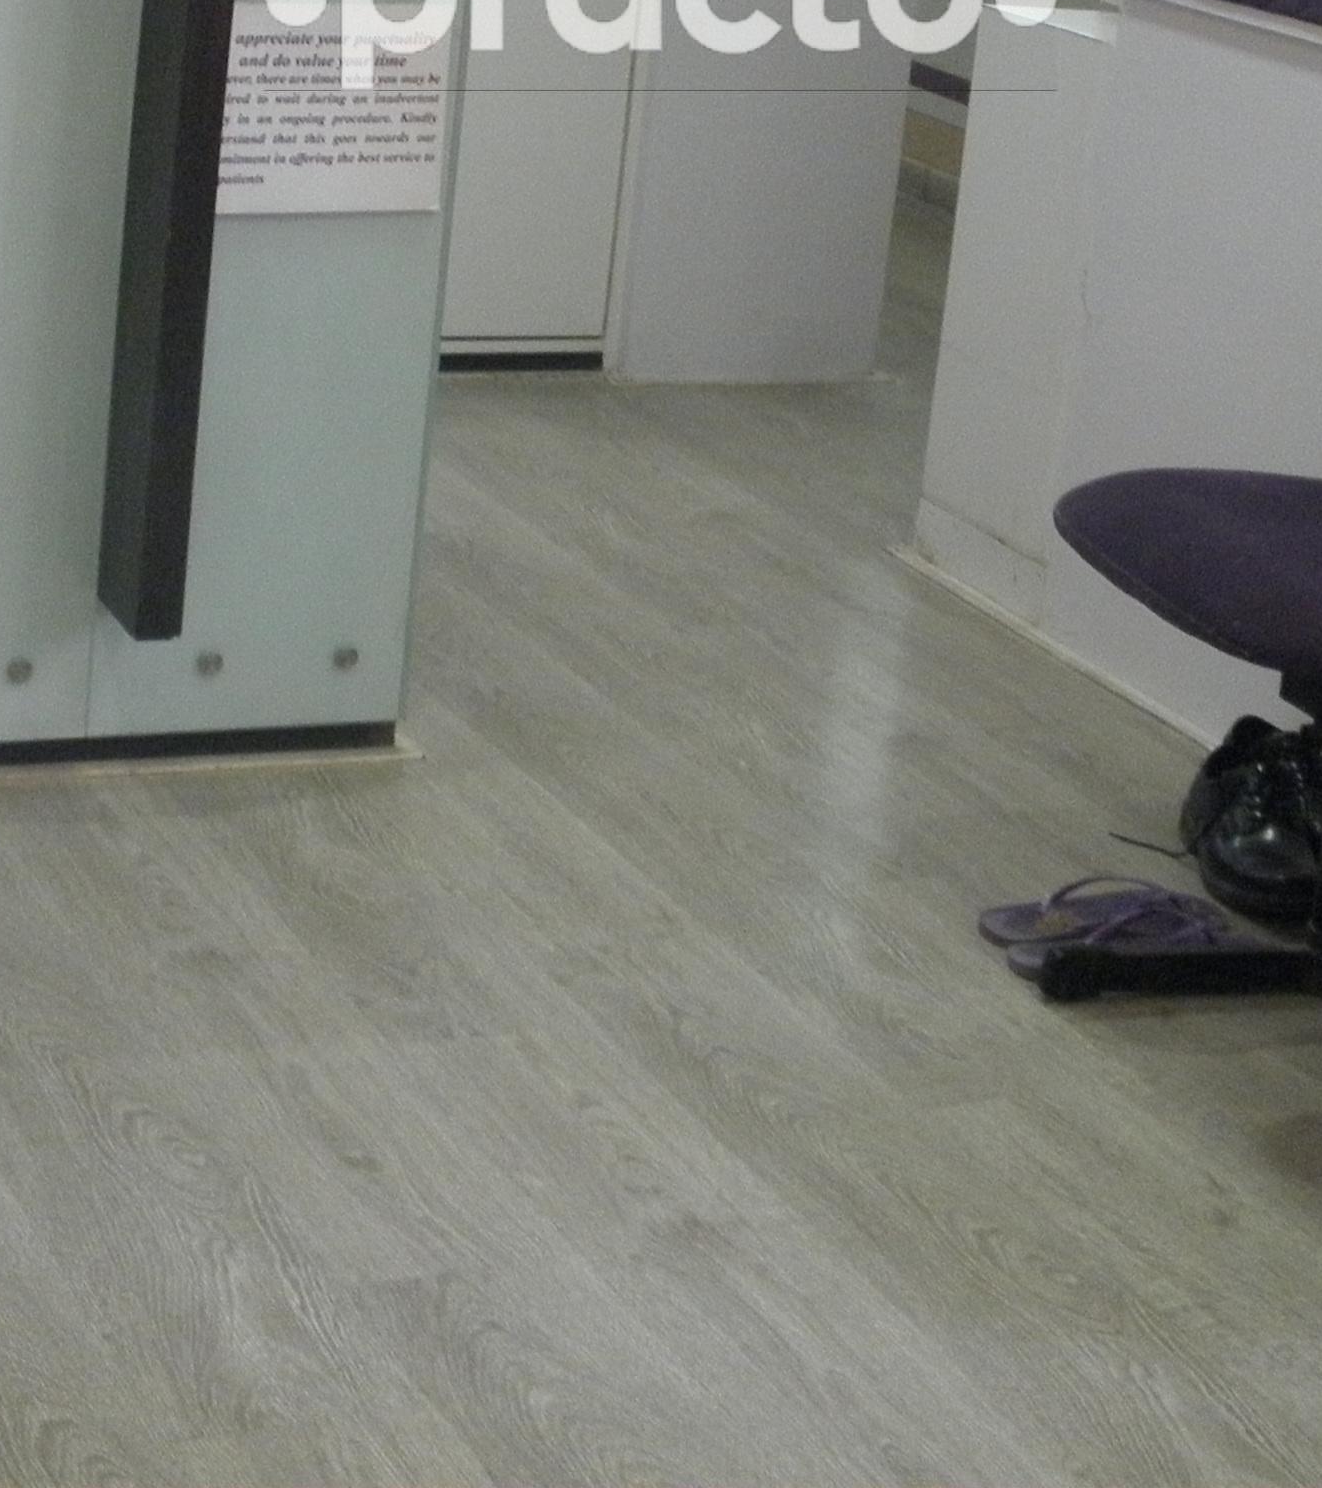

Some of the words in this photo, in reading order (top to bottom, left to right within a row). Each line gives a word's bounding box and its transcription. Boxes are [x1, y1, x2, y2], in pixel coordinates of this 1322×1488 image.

[235, 32, 314, 48] appreciate
[315, 34, 350, 48] your
[239, 53, 269, 67] and
[273, 53, 291, 67] do
[296, 53, 333, 67] value
[374, 53, 407, 68] time
[257, 73, 287, 85] there
[288, 75, 309, 85] are
[310, 73, 342, 85] times
[377, 75, 398, 87] you
[400, 75, 425, 87] may
[427, 72, 441, 85] be
[257, 94, 269, 105] to
[275, 93, 300, 105] wait
[307, 92, 346, 107] during
[353, 94, 368, 105] an
[375, 92, 440, 105] inadvertent
[238, 113, 250, 125] in
[256, 115, 272, 125] an
[279, 113, 326, 127] ongoing
[331, 113, 393, 127] procedure.
[400, 112, 438, 126] Kindly
[221, 133, 266, 145] erstand
[272, 132, 297, 145] that
[304, 132, 326, 145] this
[333, 134, 357, 147] goes
[364, 131, 409, 144] towards
[416, 133, 437, 144] our
[274, 152, 286, 165] in
[288, 152, 333, 166] offering
[337, 152, 355, 164] the
[358, 151, 380, 164] best
[383, 152, 421, 164] service
[424, 151, 436, 163] to
[218, 174, 265, 186] patients
